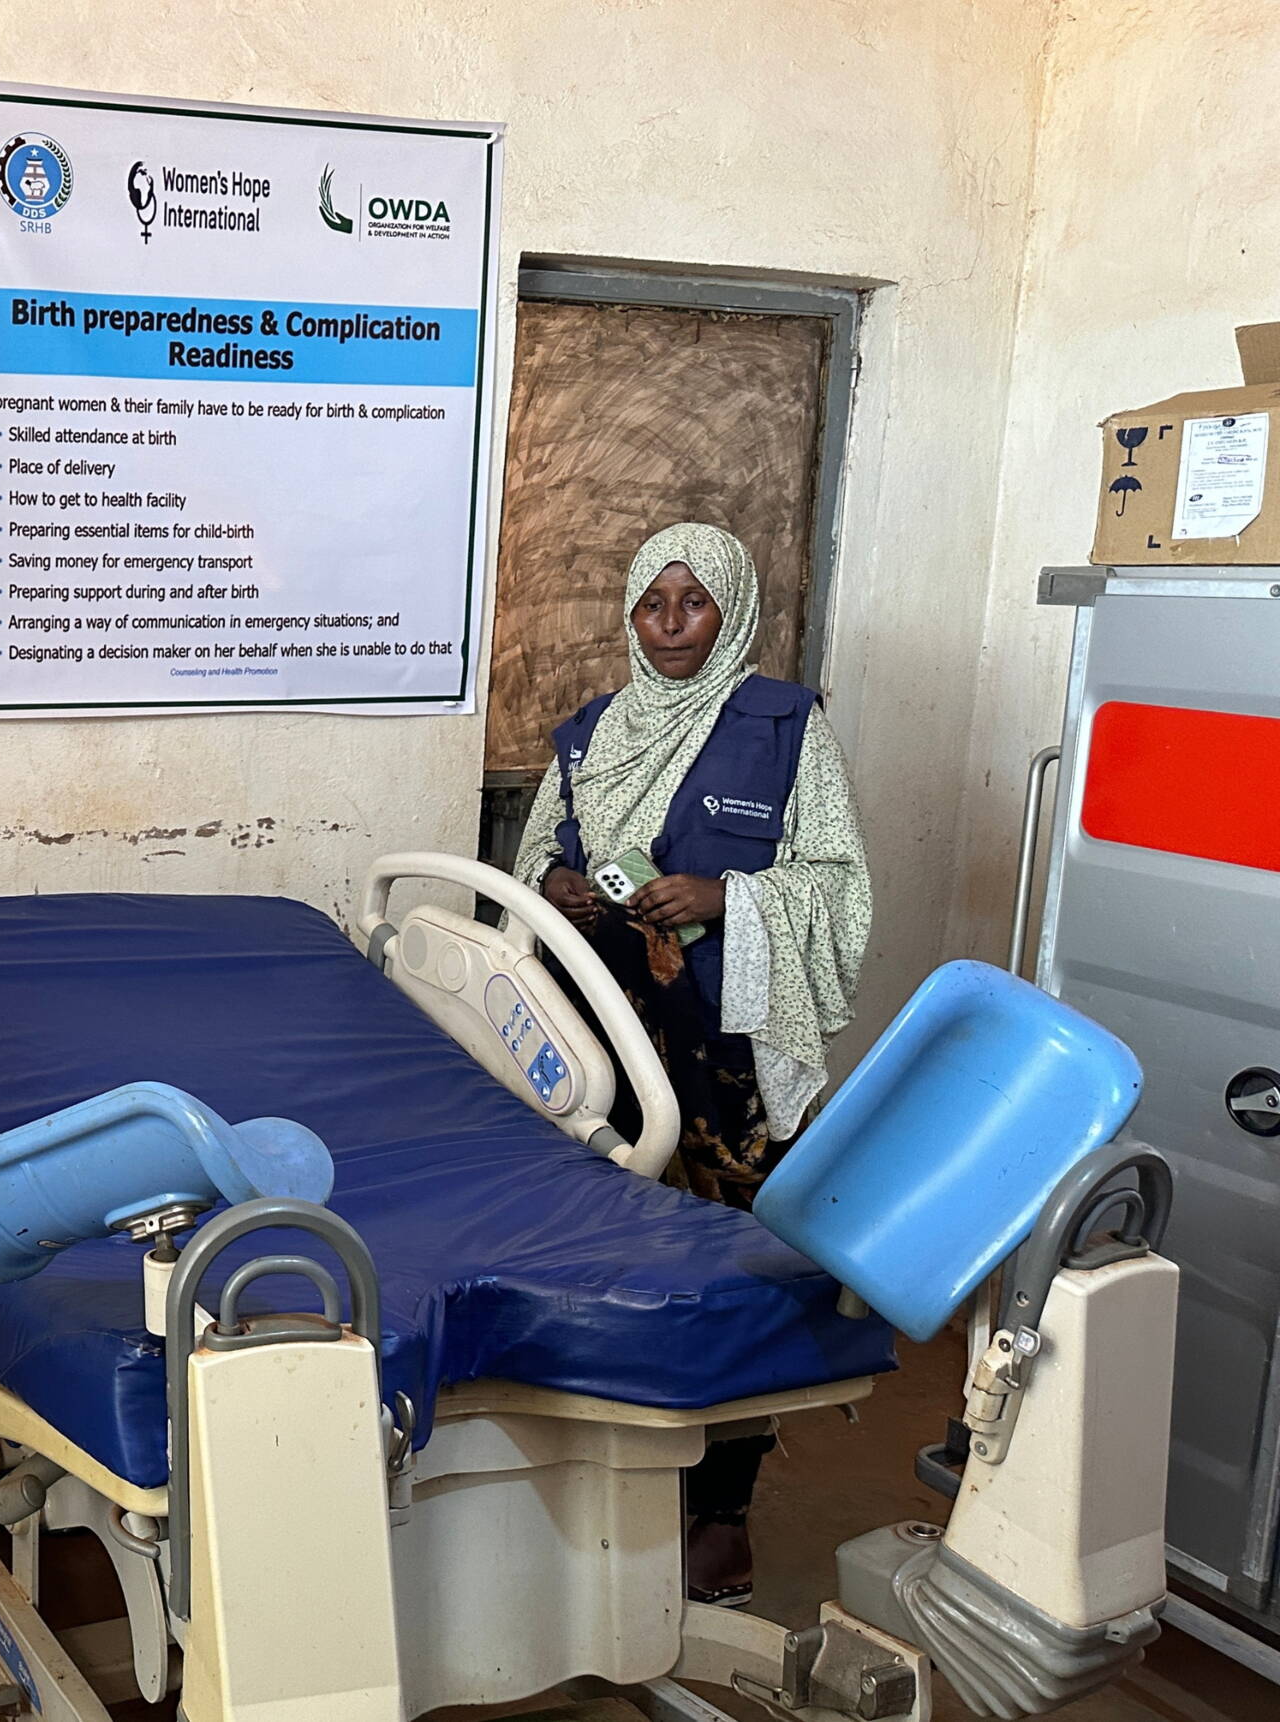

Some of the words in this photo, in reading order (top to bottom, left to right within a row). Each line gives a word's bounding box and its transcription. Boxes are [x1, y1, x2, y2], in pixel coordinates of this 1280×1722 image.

[162, 166, 228, 196] Women's
[232, 171, 270, 203] Hope
[22, 207, 47, 218] DDS
[163, 201, 260, 232] International
[368, 197, 451, 223] OWDA
[19, 220, 52, 234] SRHB
[368, 221, 411, 230] ORGANIZATION
[425, 224, 451, 232] WELFARE
[374, 230, 418, 238] DEVELOPMENT
[427, 232, 450, 240] ACTION
[12, 298, 75, 327] Birth
[83, 305, 253, 337] preparedness
[260, 310, 280, 336] &
[286, 311, 440, 344] Complication
[169, 341, 294, 370] Readiness
[58, 399, 107, 412] women
[110, 396, 121, 413] &
[124, 397, 153, 414] their
[156, 398, 195, 418] family
[197, 399, 228, 416] have
[231, 402, 245, 417] to
[248, 401, 264, 417] be
[267, 402, 303, 421] ready
[305, 402, 324, 418] for
[326, 402, 355, 418] birth
[358, 403, 369, 419] &
[371, 404, 445, 422] complication
[8, 426, 51, 443] Skilled
[54, 428, 129, 445] attendance
[132, 430, 145, 445] at
[148, 429, 177, 446] birth
[9, 458, 44, 475] Place
[46, 458, 62, 475] of
[63, 459, 116, 479] delivery
[9, 490, 38, 506] How
[42, 491, 56, 507] to
[59, 492, 81, 510] get
[84, 492, 98, 507] to
[101, 491, 143, 508] health
[146, 492, 187, 511] facility
[9, 521, 70, 541] Preparing
[74, 522, 130, 538] essential
[134, 523, 169, 538] items
[172, 523, 191, 539] for
[194, 523, 254, 539] child-birth
[8, 552, 51, 572] Saving
[55, 556, 99, 572] money
[102, 553, 121, 569] for
[123, 557, 195, 572] emergency
[197, 554, 253, 572] transport
[9, 583, 70, 603] Preparing
[73, 585, 123, 602] support
[125, 584, 166, 602] during
[169, 584, 194, 599] and
[196, 583, 228, 599] after
[231, 584, 259, 599] birth
[8, 614, 70, 633] Arranging
[74, 617, 82, 629] a
[85, 617, 112, 633] way
[115, 613, 130, 629] of
[131, 614, 226, 629] communication
[229, 614, 241, 629] in
[244, 616, 311, 632] emergency
[313, 613, 373, 630] situations;
[376, 612, 400, 627] and
[9, 644, 83, 663] Designating
[86, 647, 95, 660] a
[98, 644, 149, 659] decision
[152, 643, 192, 659] maker
[194, 646, 211, 658] on
[214, 643, 236, 658] her
[238, 642, 278, 658] behalf
[280, 643, 313, 657] when
[316, 642, 337, 657] she
[340, 642, 350, 657] is
[353, 641, 392, 656] unable
[394, 642, 407, 656] to
[410, 641, 426, 655] do
[428, 640, 453, 655] that
[208, 667, 221, 676] and
[221, 667, 243, 675] Health
[244, 667, 278, 675] Promotion
[722, 797, 755, 808] Women's
[755, 801, 773, 812] Hope
[722, 805, 770, 819] International
